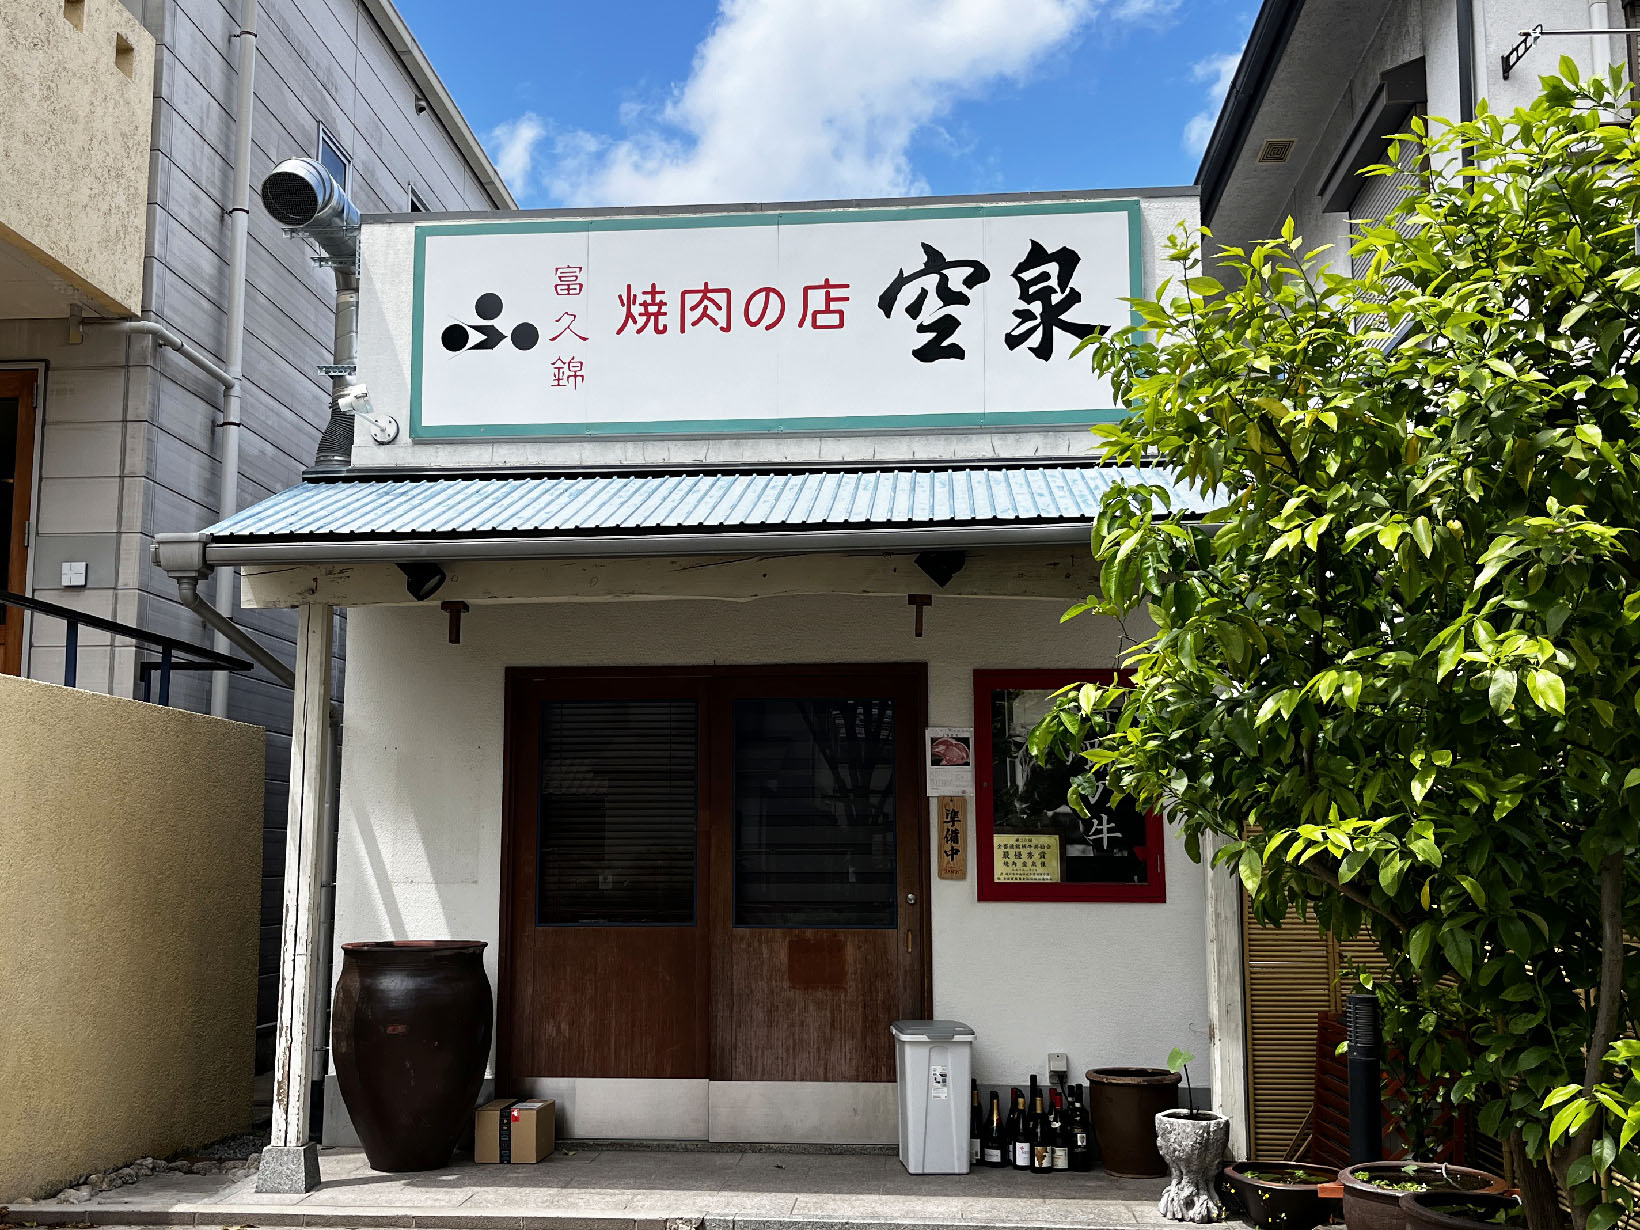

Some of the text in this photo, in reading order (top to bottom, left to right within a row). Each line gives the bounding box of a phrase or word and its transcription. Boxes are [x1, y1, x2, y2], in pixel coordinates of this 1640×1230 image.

[548, 264, 590, 391] 富久錦
[615, 236, 1112, 363] 焼肉の店 空泉
[943, 807, 962, 863] 準備中
